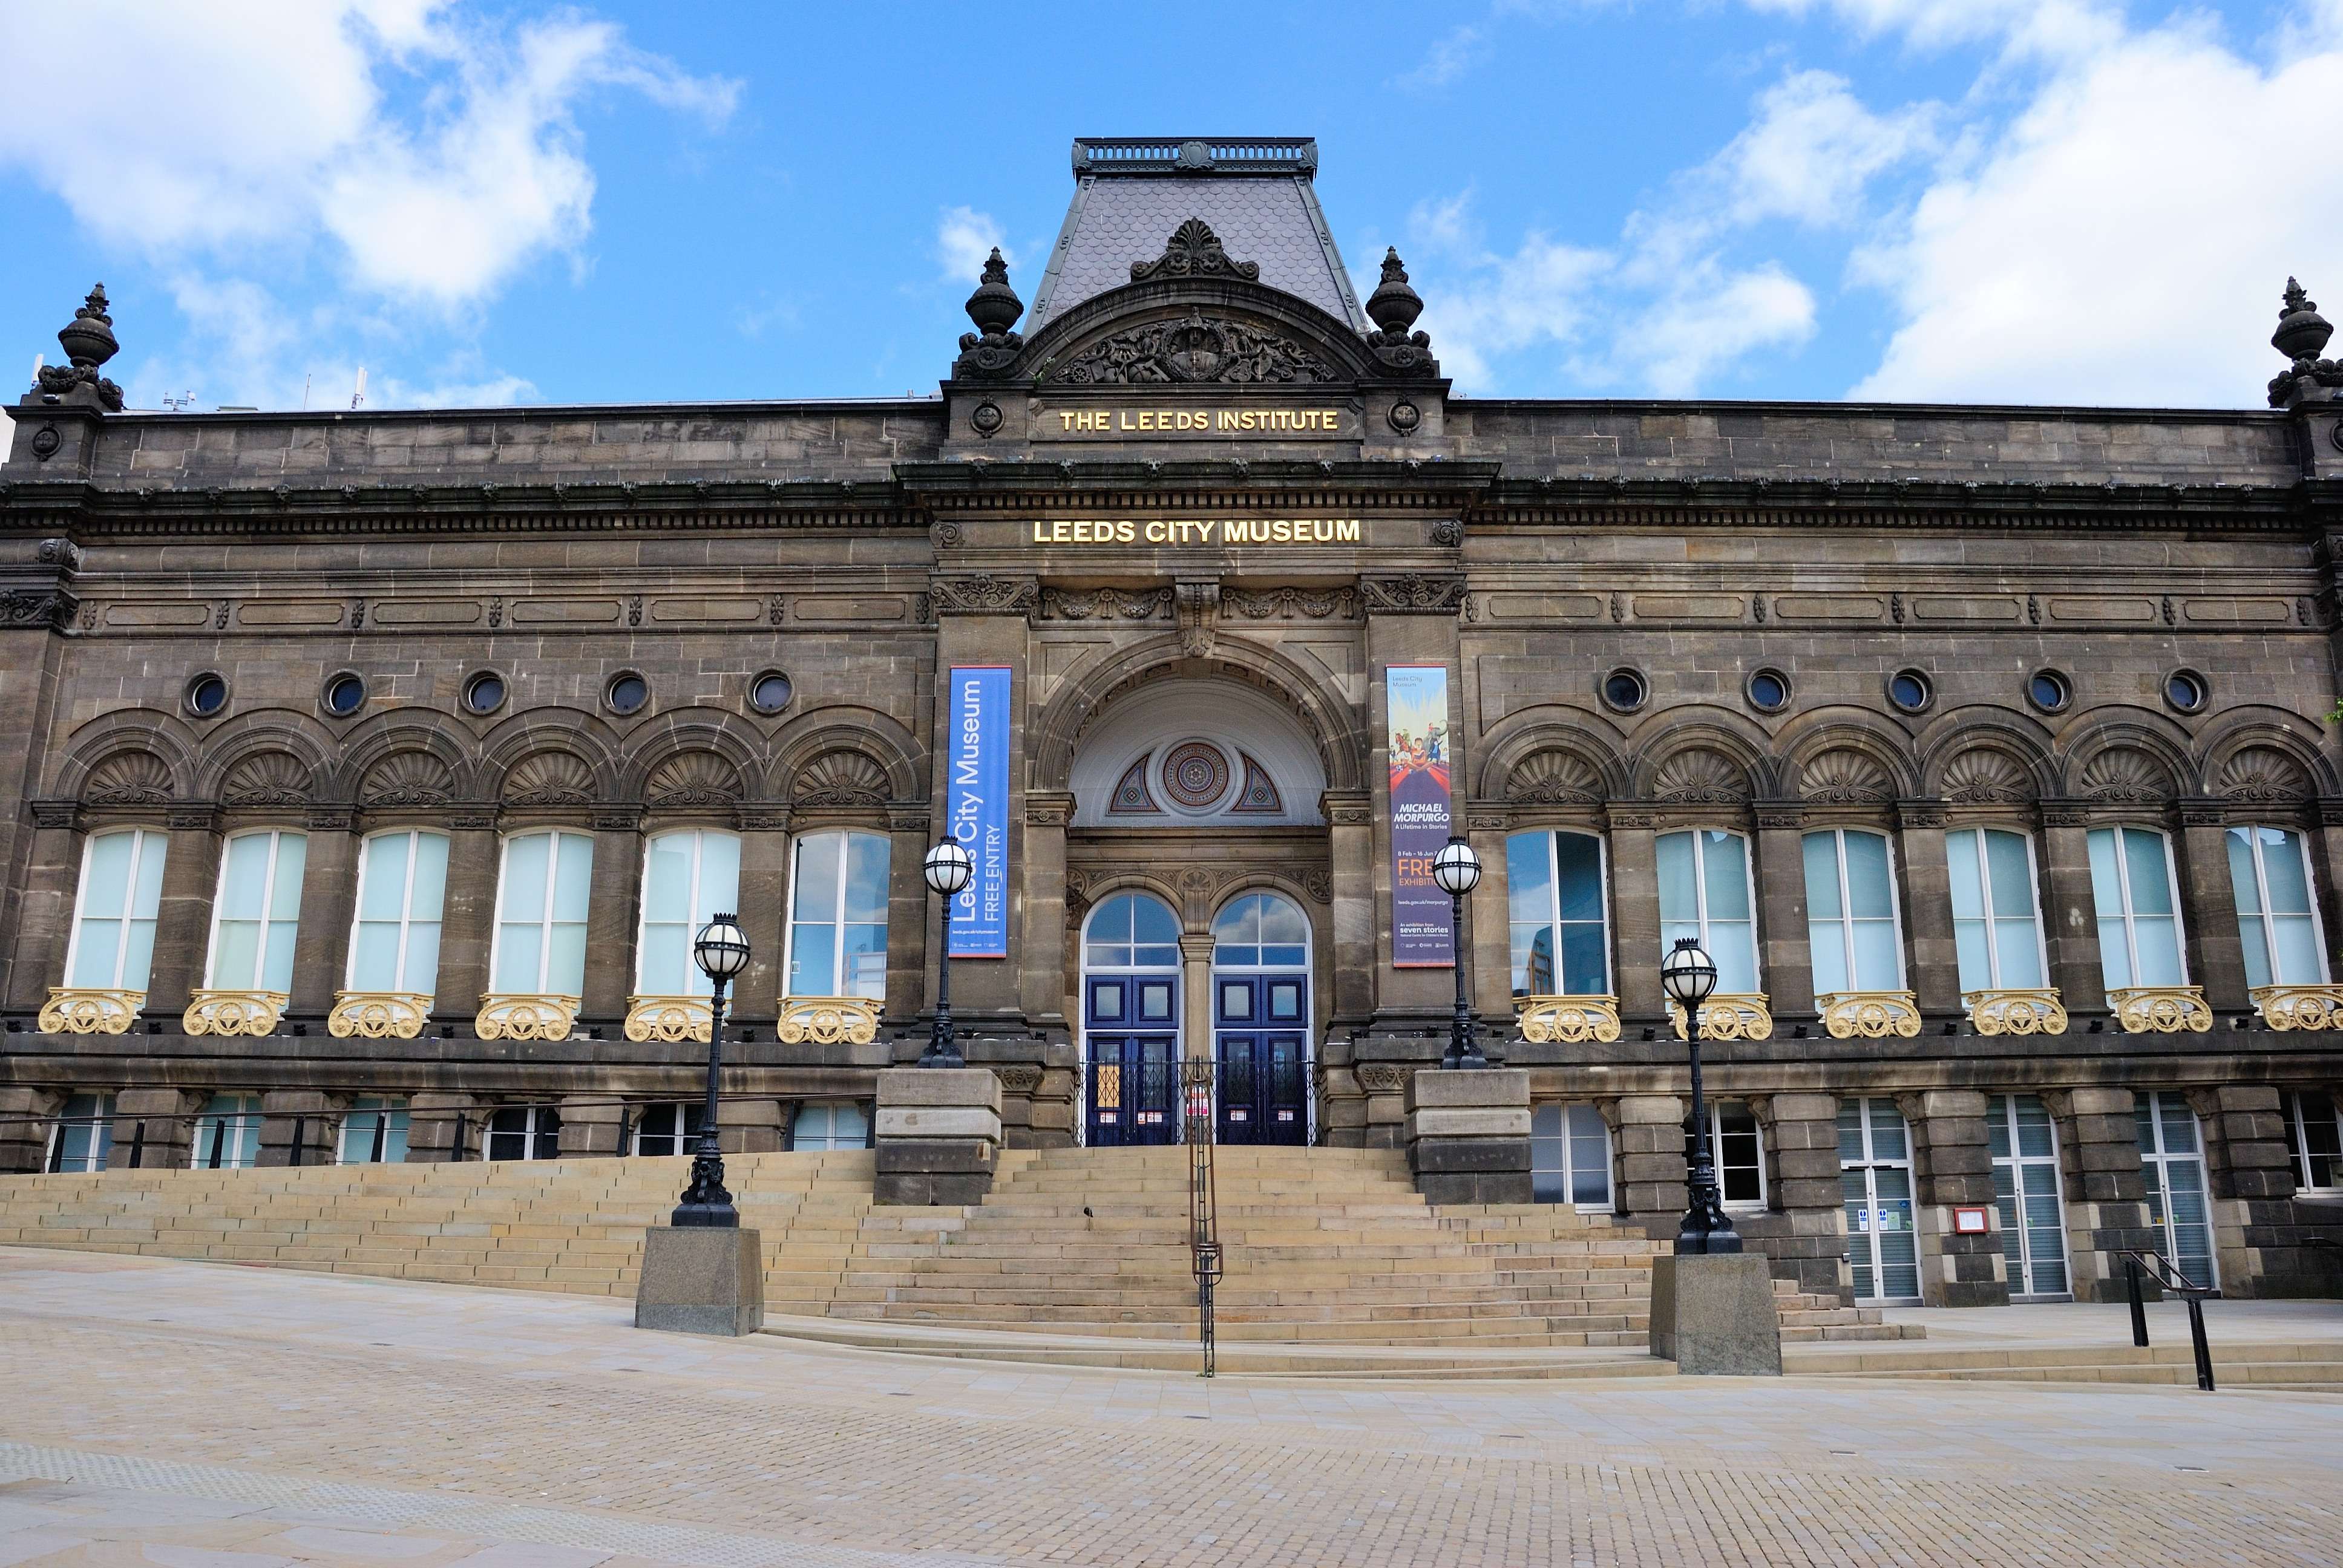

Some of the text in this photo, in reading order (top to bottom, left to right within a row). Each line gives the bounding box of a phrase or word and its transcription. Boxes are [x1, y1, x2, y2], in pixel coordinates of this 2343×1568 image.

[1059, 411, 1339, 430] THE LEEDS INSTITUTE
[1034, 520, 1360, 543] LEEDS CITY MUSEUM
[955, 680, 981, 785] Museum
[954, 791, 983, 843] City
[1394, 812, 1450, 822] MORPURGO
[1400, 803, 1443, 812] MICHAEL
[985, 823, 1000, 921] FREE ENTRY
[1398, 859, 1434, 876] FRE
